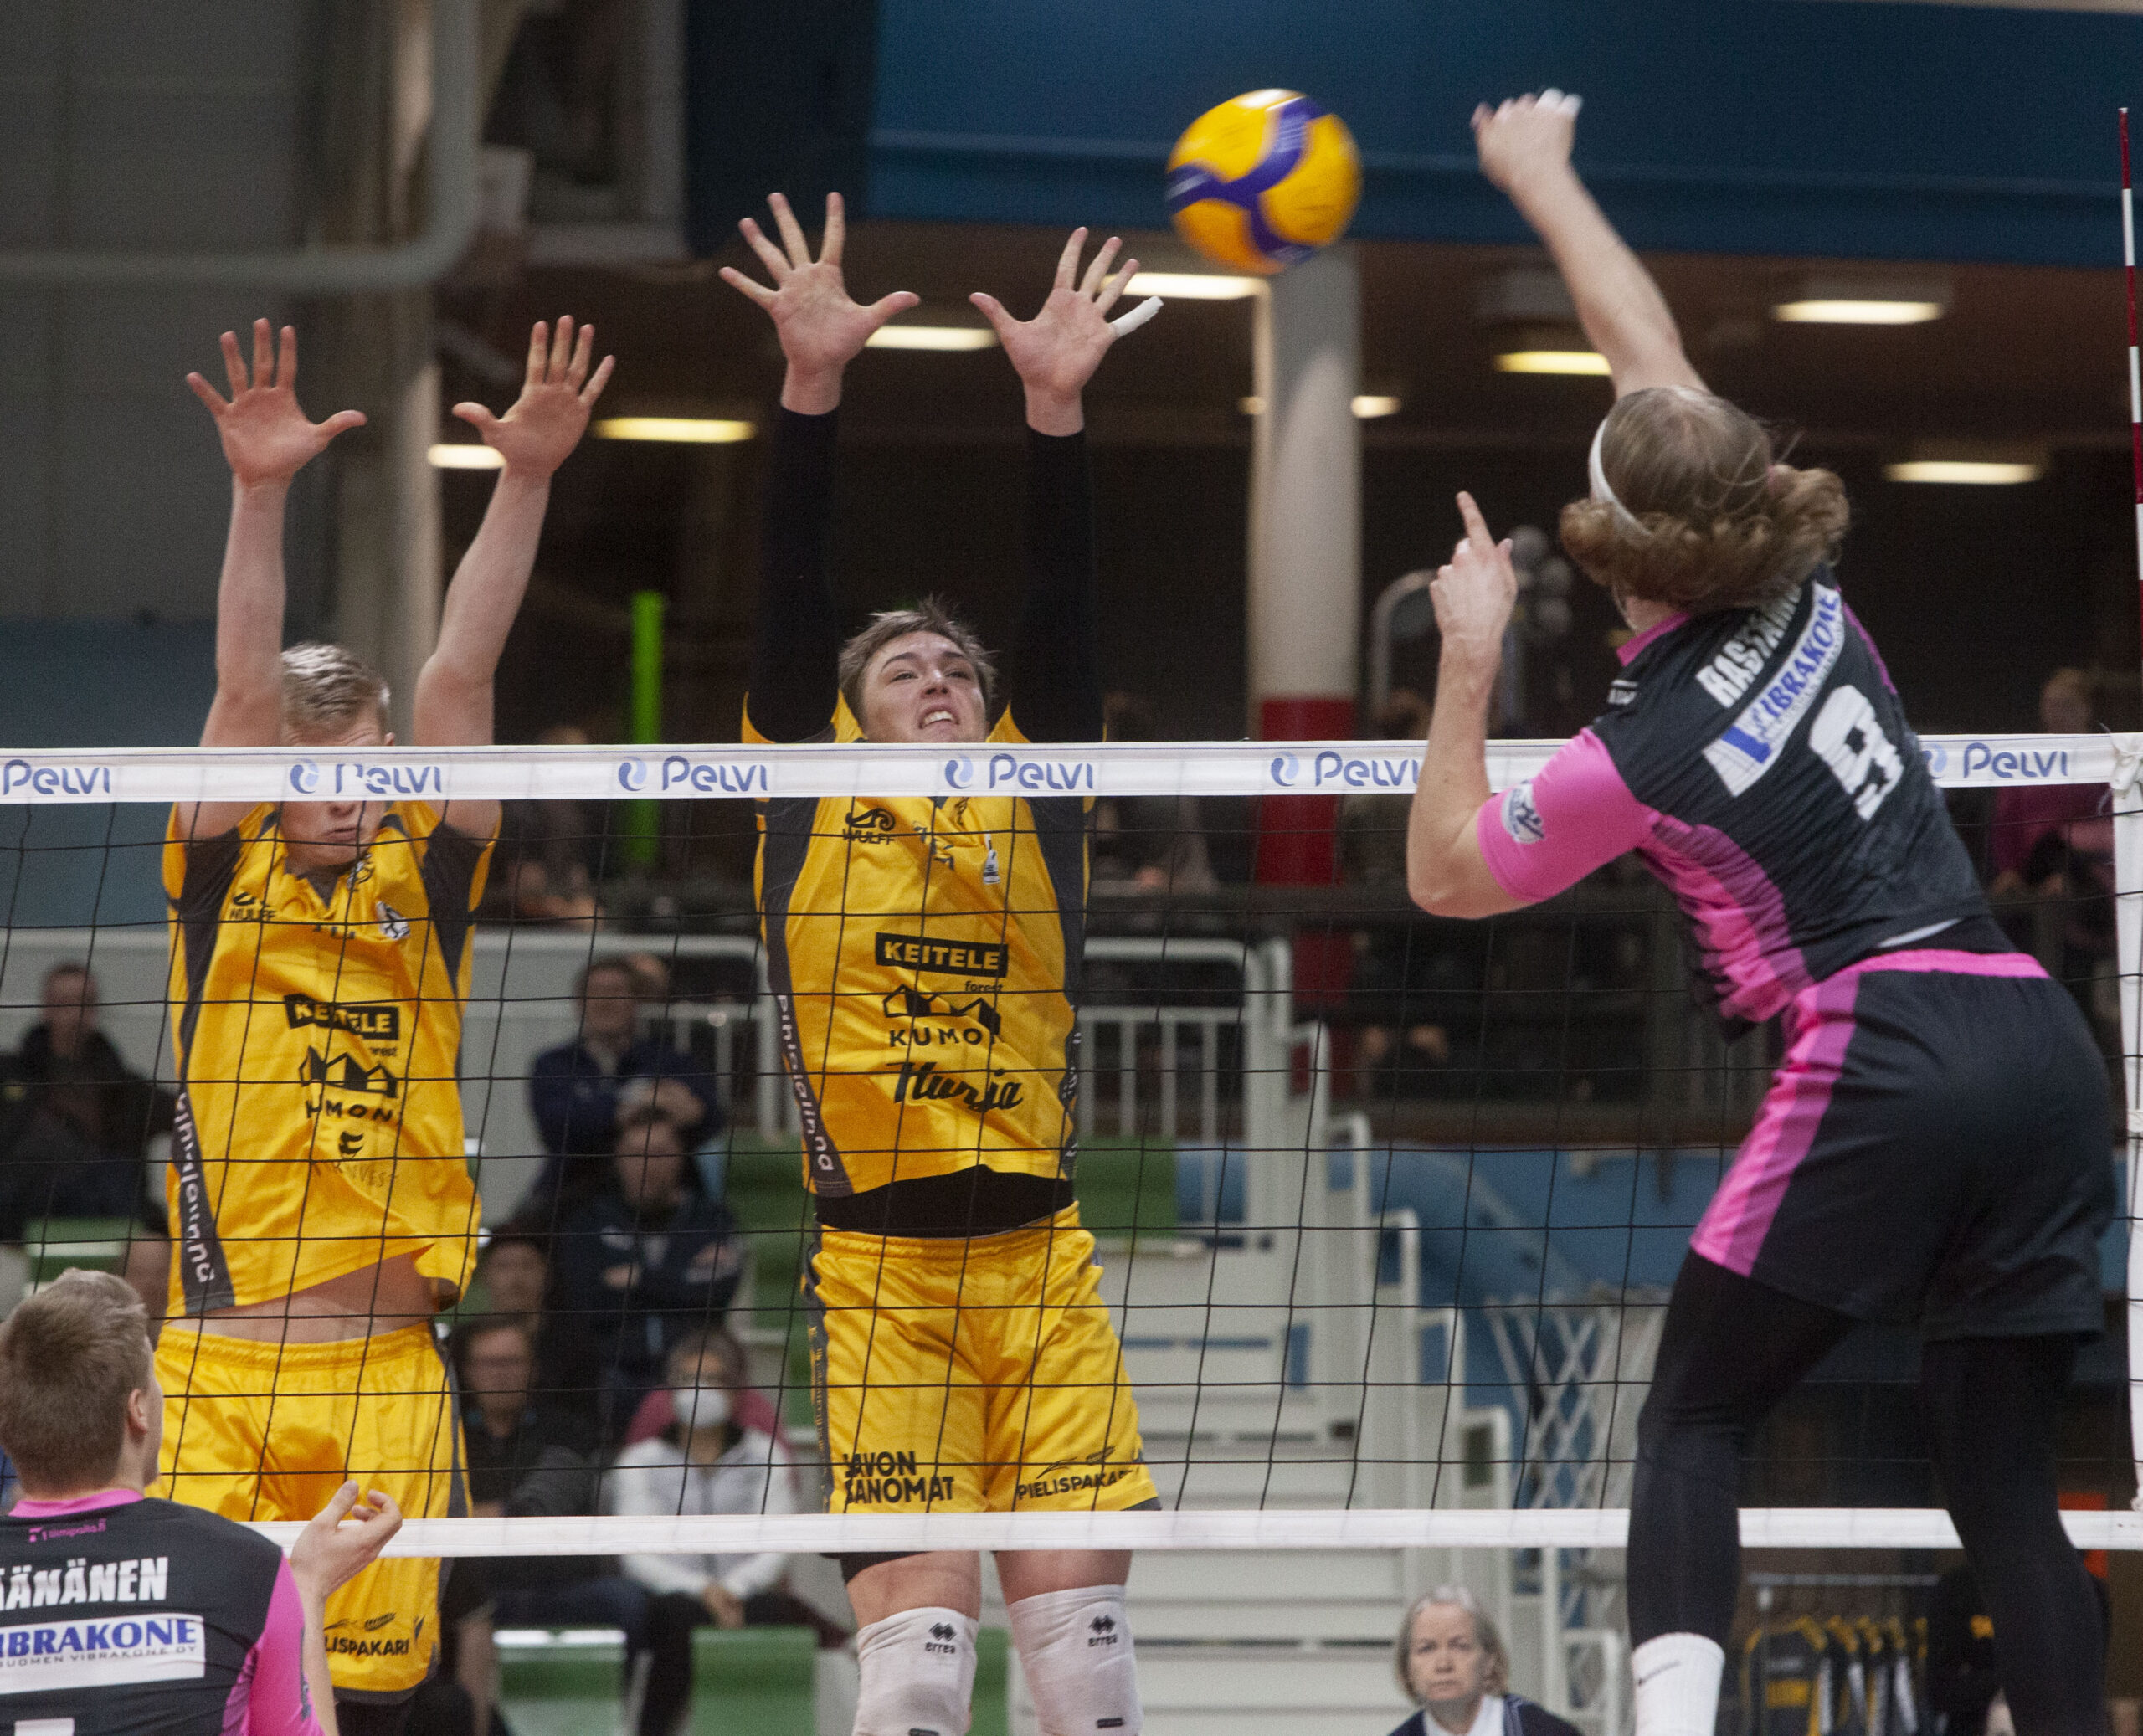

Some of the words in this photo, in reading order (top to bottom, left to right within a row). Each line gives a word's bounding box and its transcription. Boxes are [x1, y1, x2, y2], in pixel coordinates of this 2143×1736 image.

[1808, 684, 1904, 821] 9
[883, 941, 1001, 970] KEITELE
[964, 980, 1004, 994] forest
[889, 1026, 996, 1047] KUMO
[0, 1557, 168, 1610] ÄNÄNEN
[69, 1648, 167, 1662] VIBRAKONE
